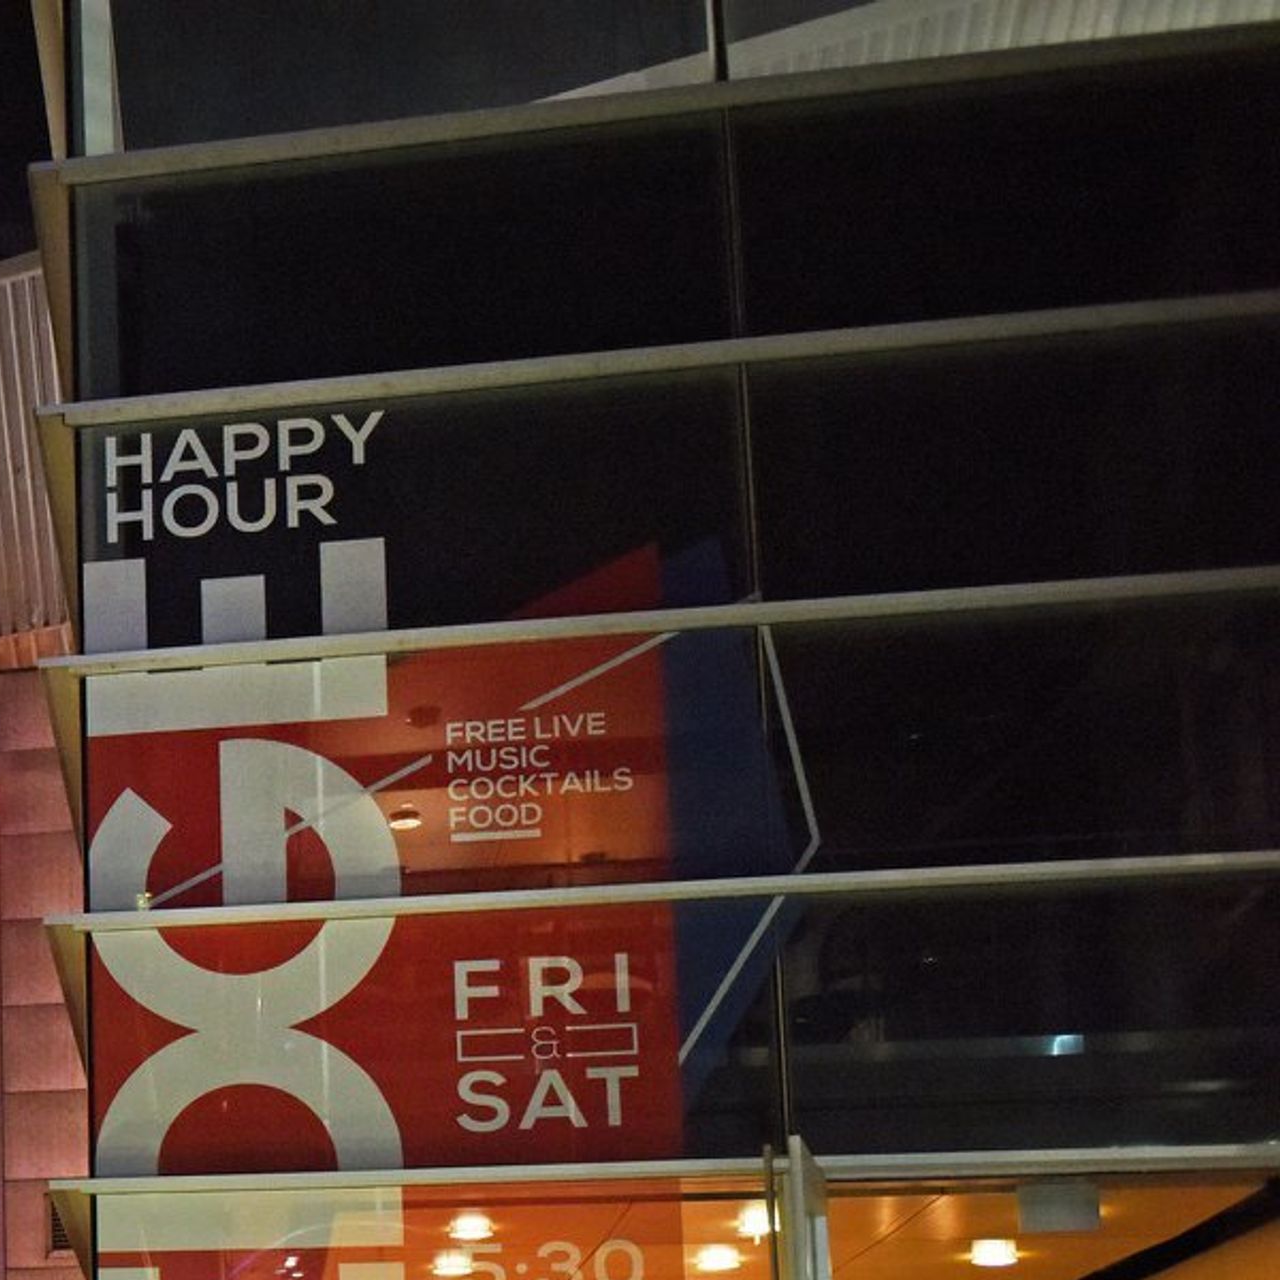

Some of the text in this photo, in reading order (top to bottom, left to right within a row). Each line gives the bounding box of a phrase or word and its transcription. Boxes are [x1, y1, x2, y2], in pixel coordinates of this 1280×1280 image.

[104, 410, 385, 488] HAPPY
[106, 473, 338, 544] HOUR
[446, 712, 607, 745] FREE LIVE
[446, 744, 551, 774] MUSIC
[448, 767, 634, 802] COCKTAILS
[449, 803, 543, 830] FOOD
[453, 952, 631, 1021] FRI
[530, 1026, 562, 1060] &
[456, 1065, 640, 1132] SAT
